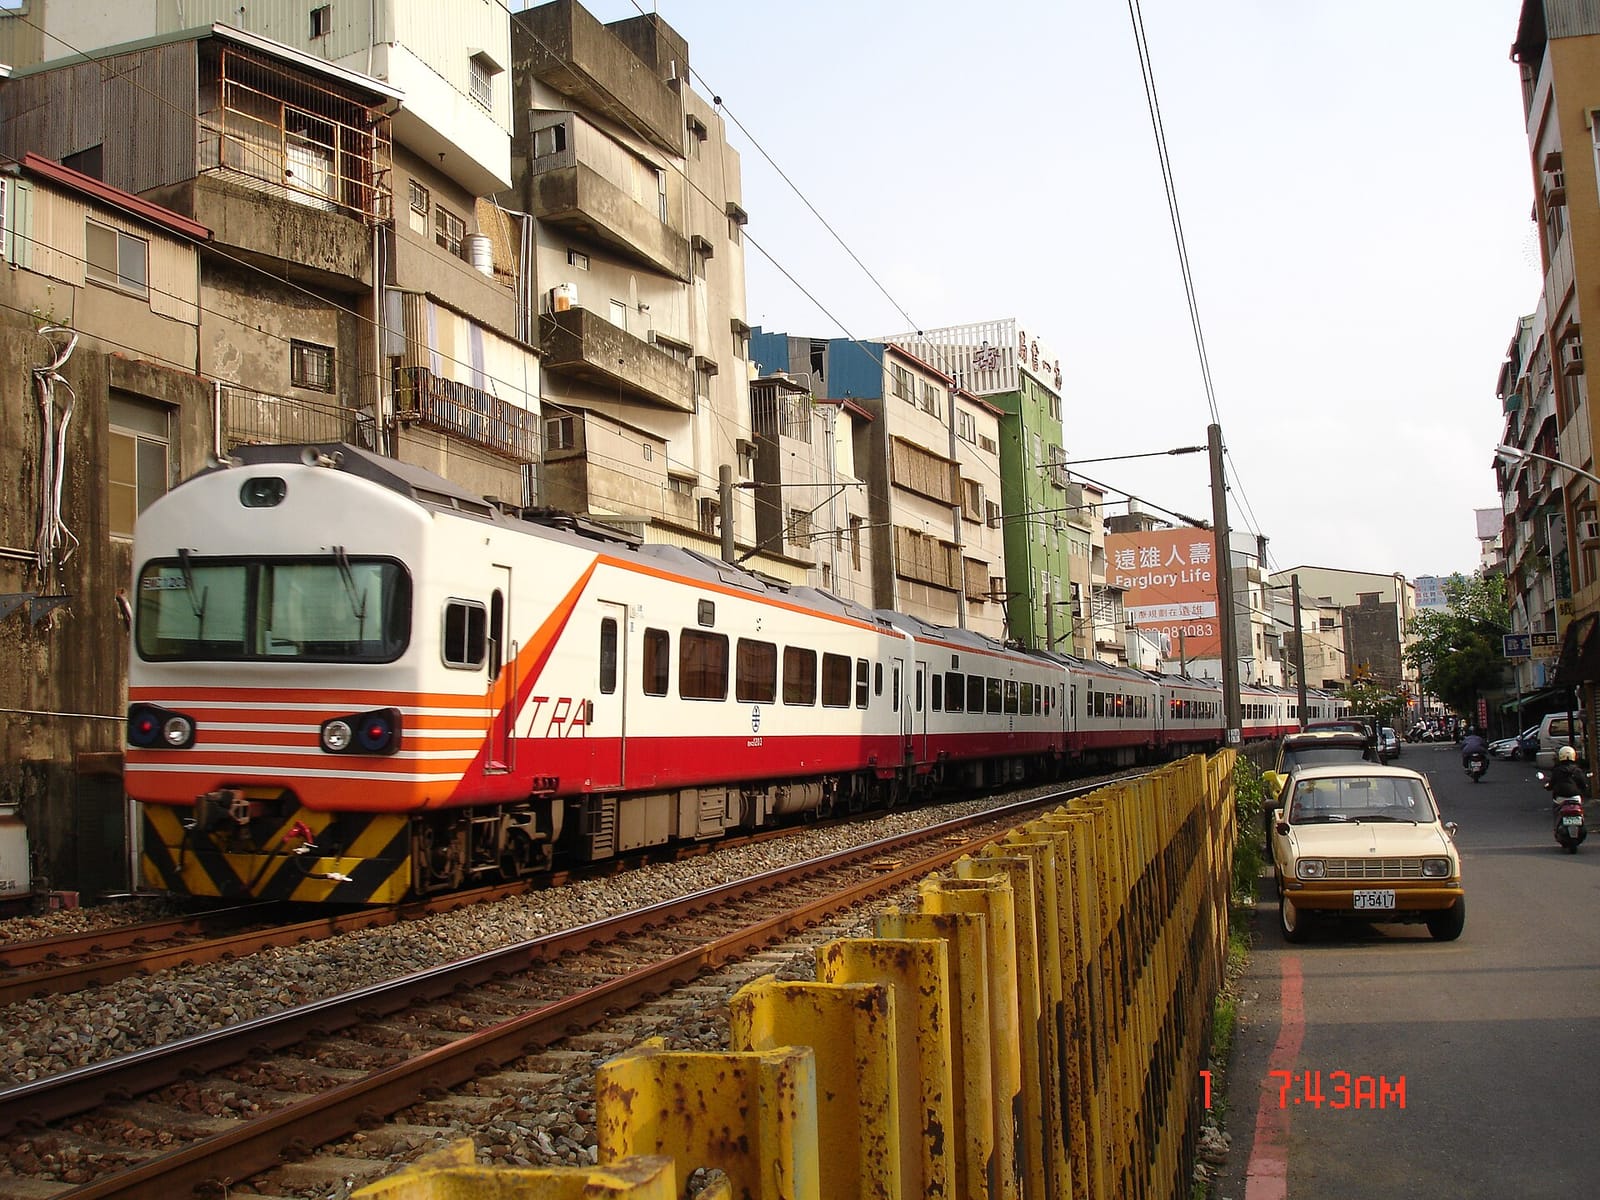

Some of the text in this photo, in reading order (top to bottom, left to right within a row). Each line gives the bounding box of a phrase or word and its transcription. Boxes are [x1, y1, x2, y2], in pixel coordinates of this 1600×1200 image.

[1115, 542, 1211, 571] 遠雄人壽
[1115, 568, 1211, 590] Farglory Life
[527, 696, 586, 738] TRA
